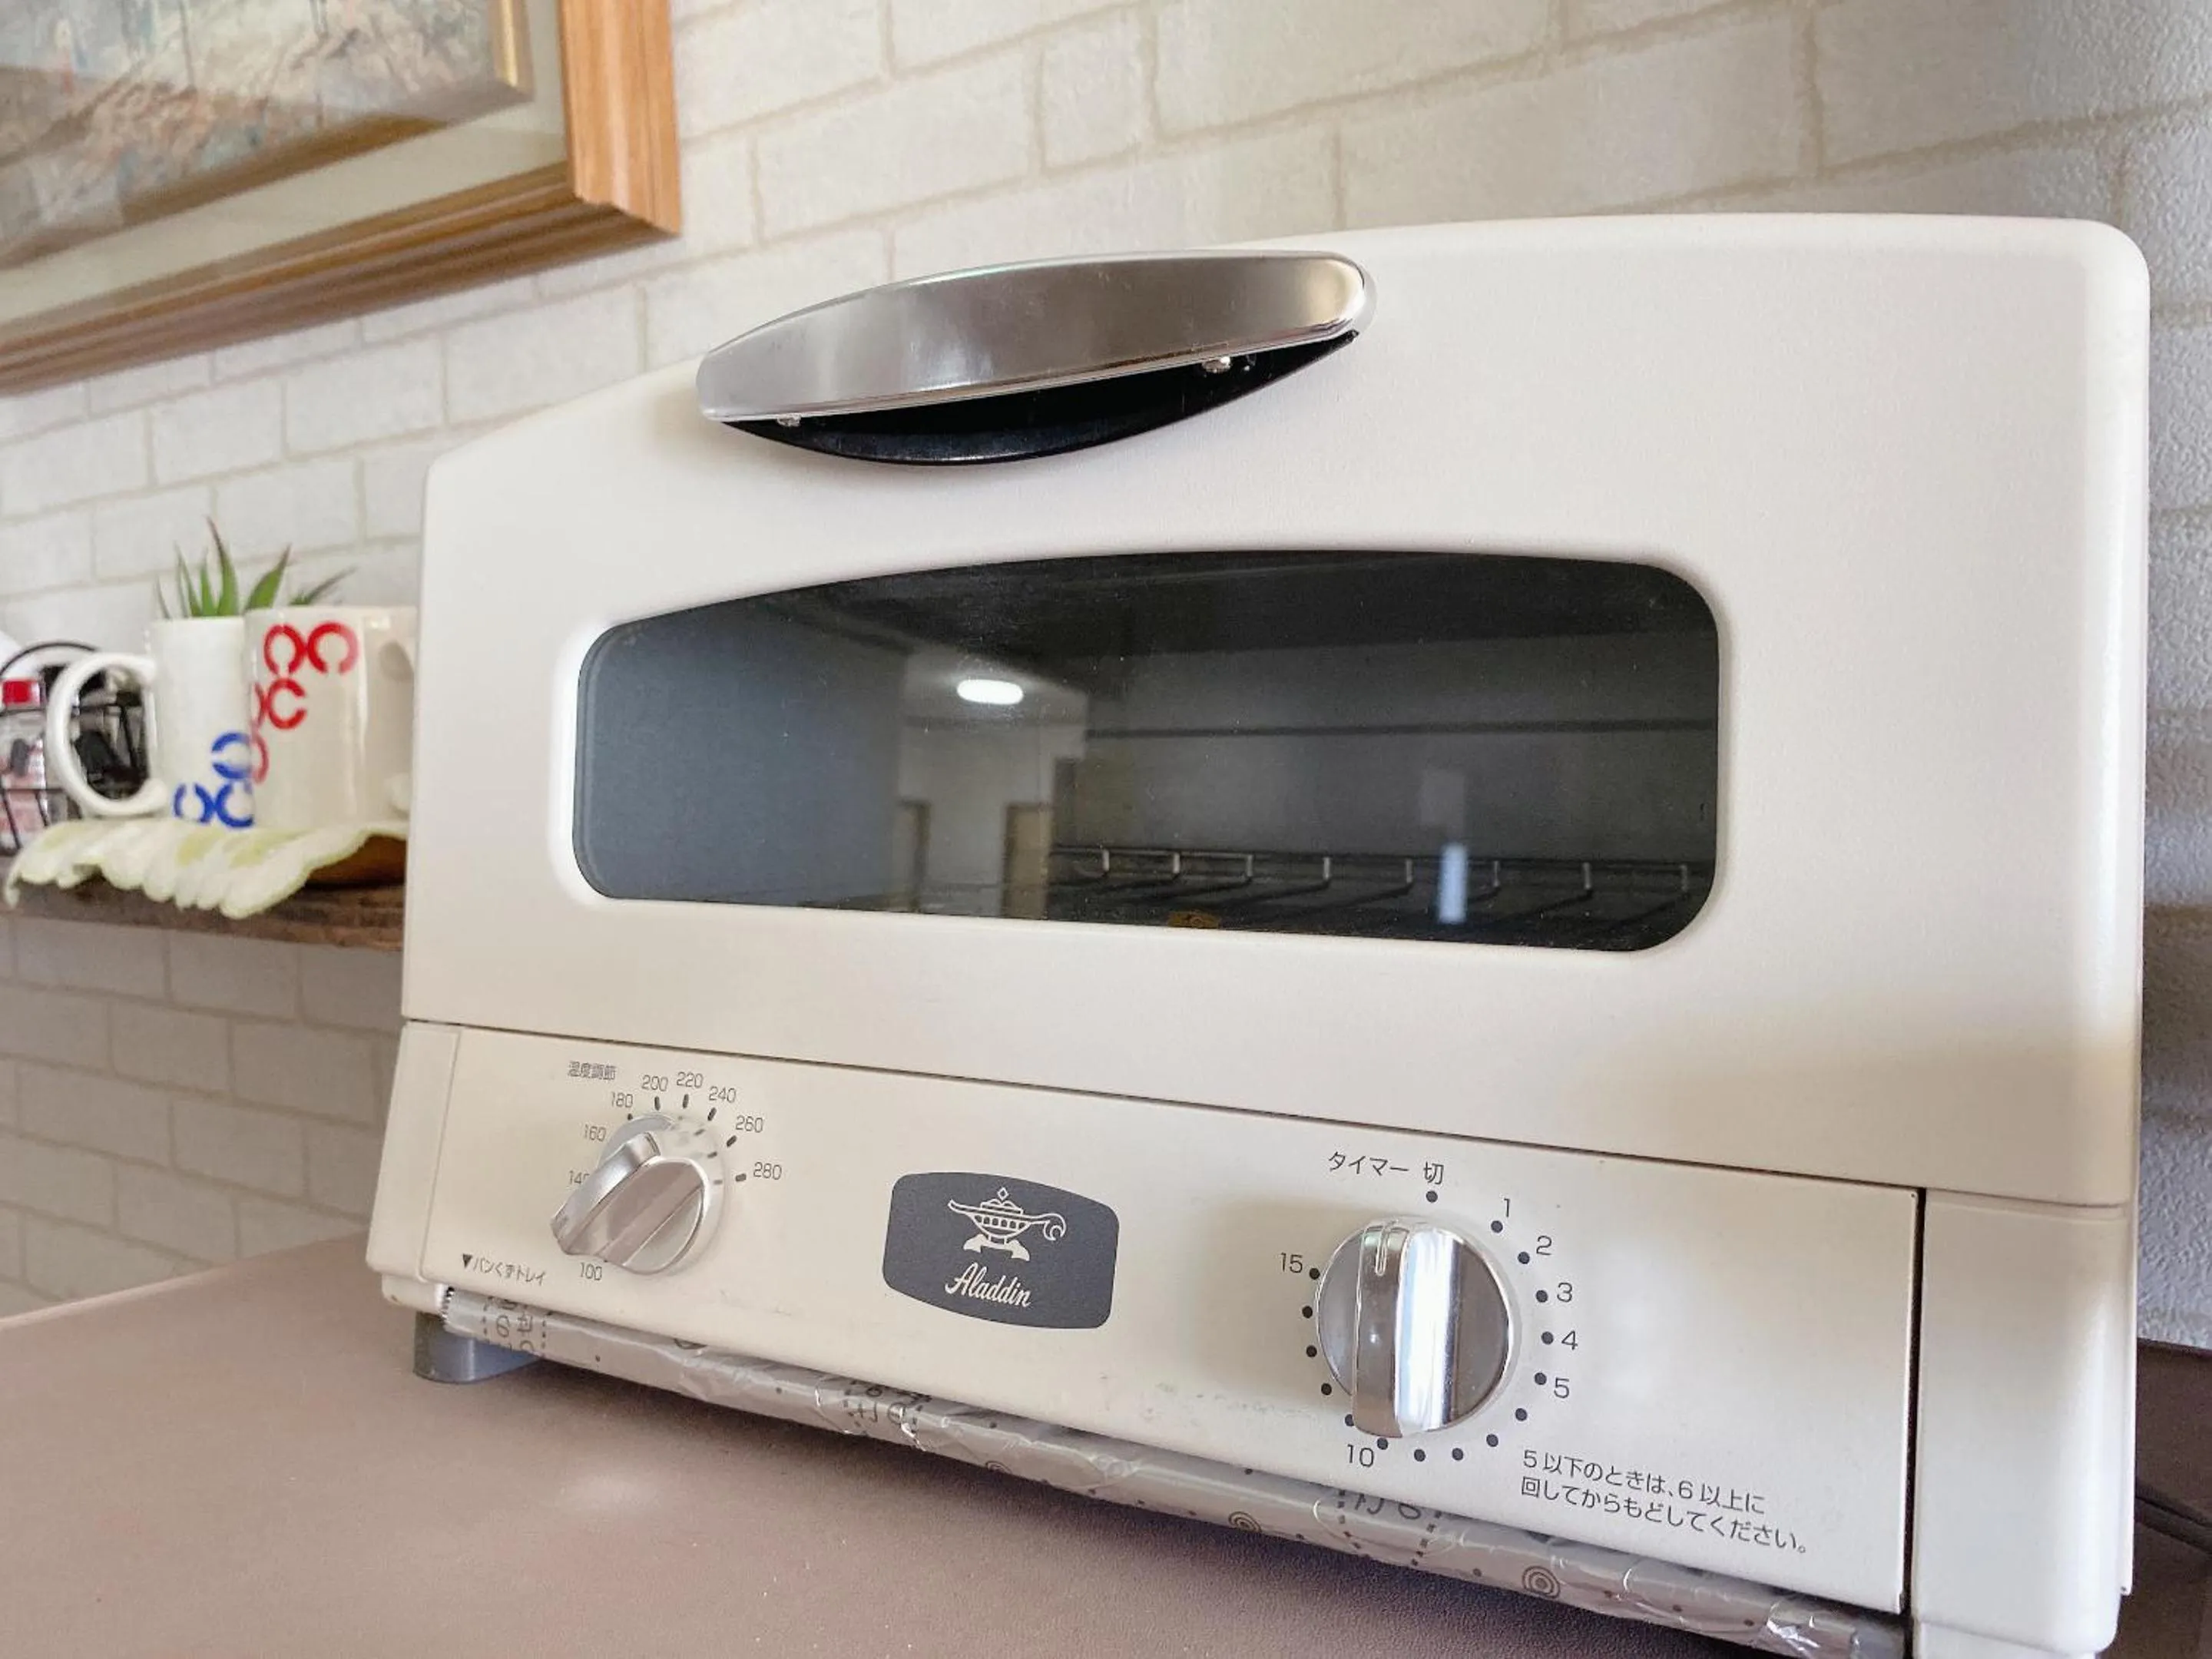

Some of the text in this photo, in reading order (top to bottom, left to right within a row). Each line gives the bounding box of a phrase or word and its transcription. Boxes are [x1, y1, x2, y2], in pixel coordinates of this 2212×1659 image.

[641, 1075, 668, 1091] 200
[676, 1071, 704, 1088] 220
[611, 1091, 634, 1108] 180
[708, 1086, 736, 1104] 240
[584, 1124, 607, 1142] 160
[735, 1115, 763, 1133] 260
[753, 1161, 783, 1181] 280
[1328, 1151, 1445, 1185] タイマー 切
[1503, 1198, 1512, 1217] 1
[1536, 1235, 1552, 1256] 2
[580, 1262, 603, 1281] 100
[1279, 1253, 1303, 1274] 15
[945, 1262, 1032, 1308] Aladdin
[1556, 1283, 1573, 1303] 3
[1561, 1330, 1578, 1351] 4
[1554, 1378, 1570, 1399] 5
[1346, 1444, 1375, 1468] 10
[1521, 1475, 1806, 1554] 回してからもどしてください。
